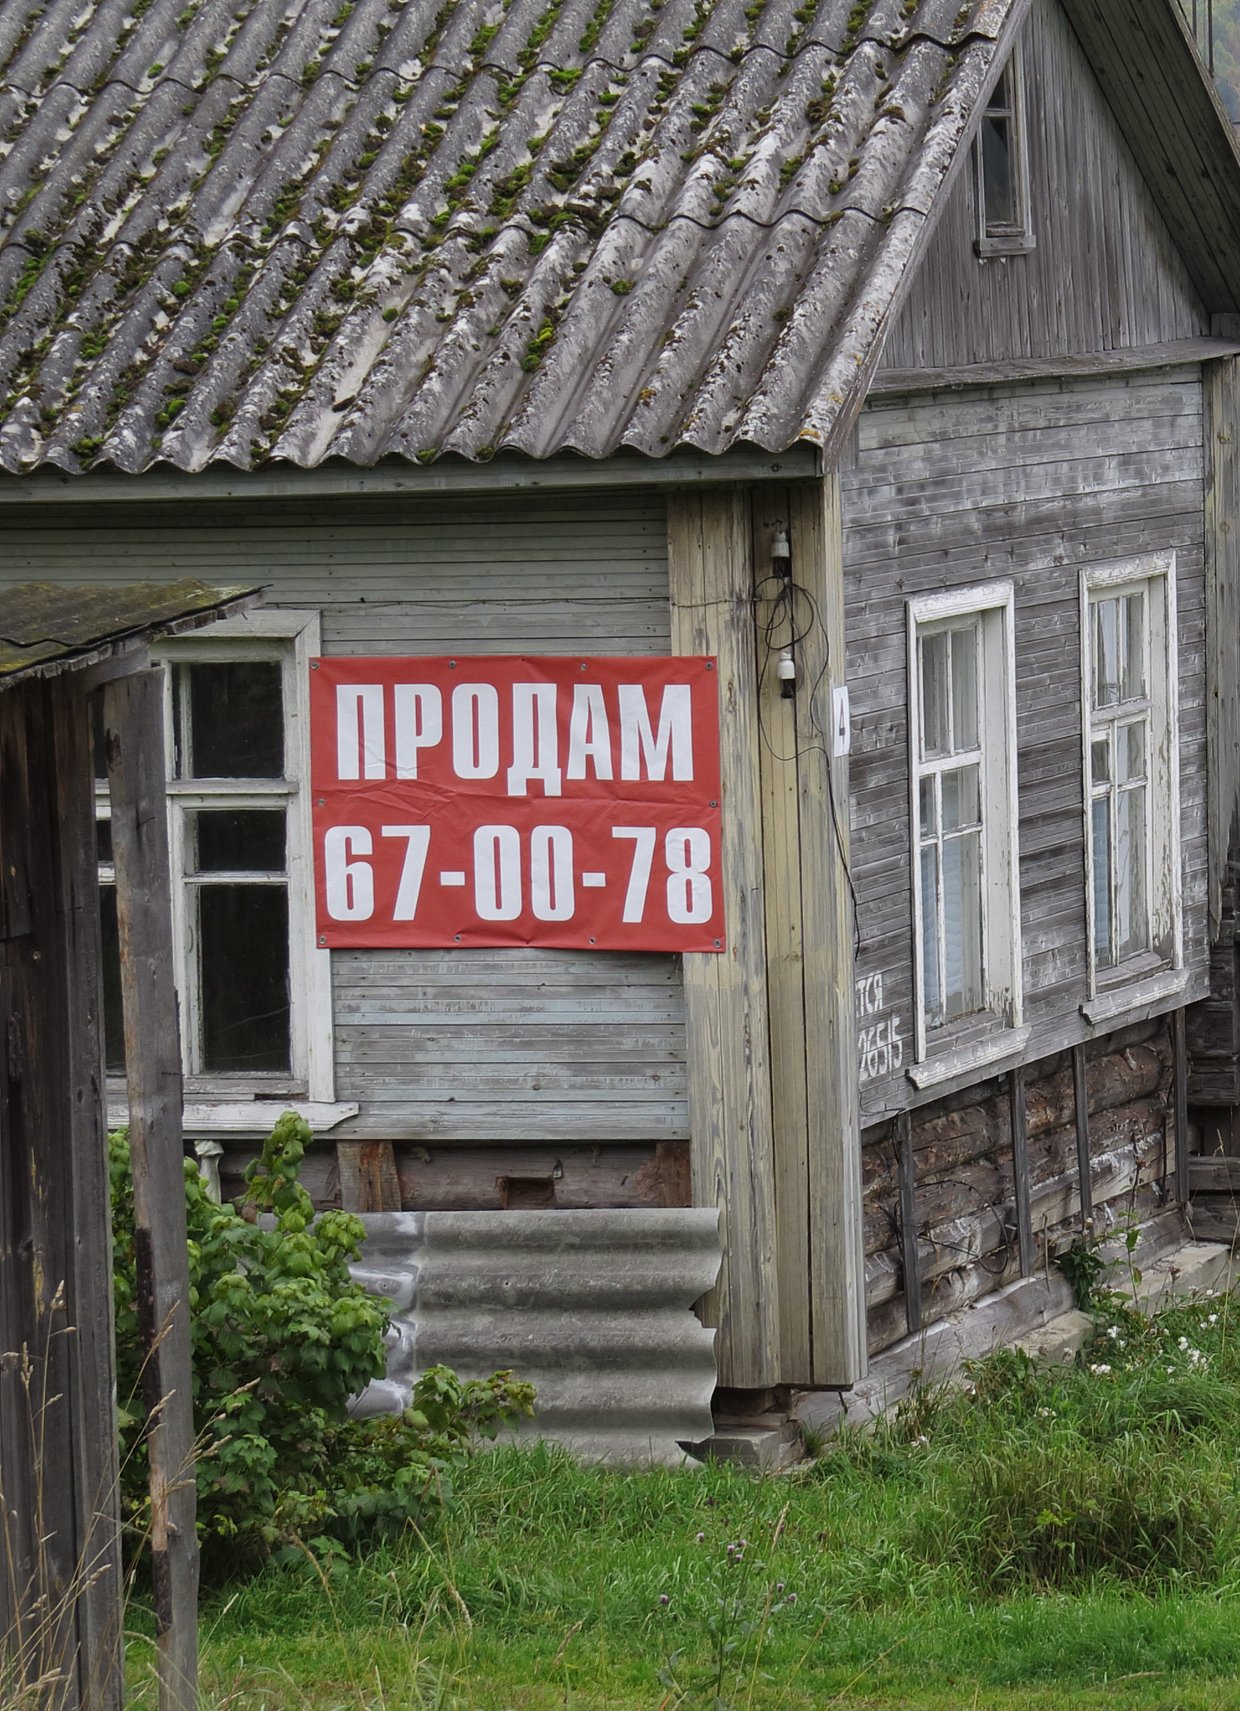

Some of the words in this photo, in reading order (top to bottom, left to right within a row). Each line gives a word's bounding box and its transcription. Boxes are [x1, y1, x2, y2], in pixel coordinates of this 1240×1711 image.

[335, 682, 694, 797] ПРОДАМ
[324, 824, 713, 925] 67-00-78
[856, 972, 883, 1019] ТСЯ
